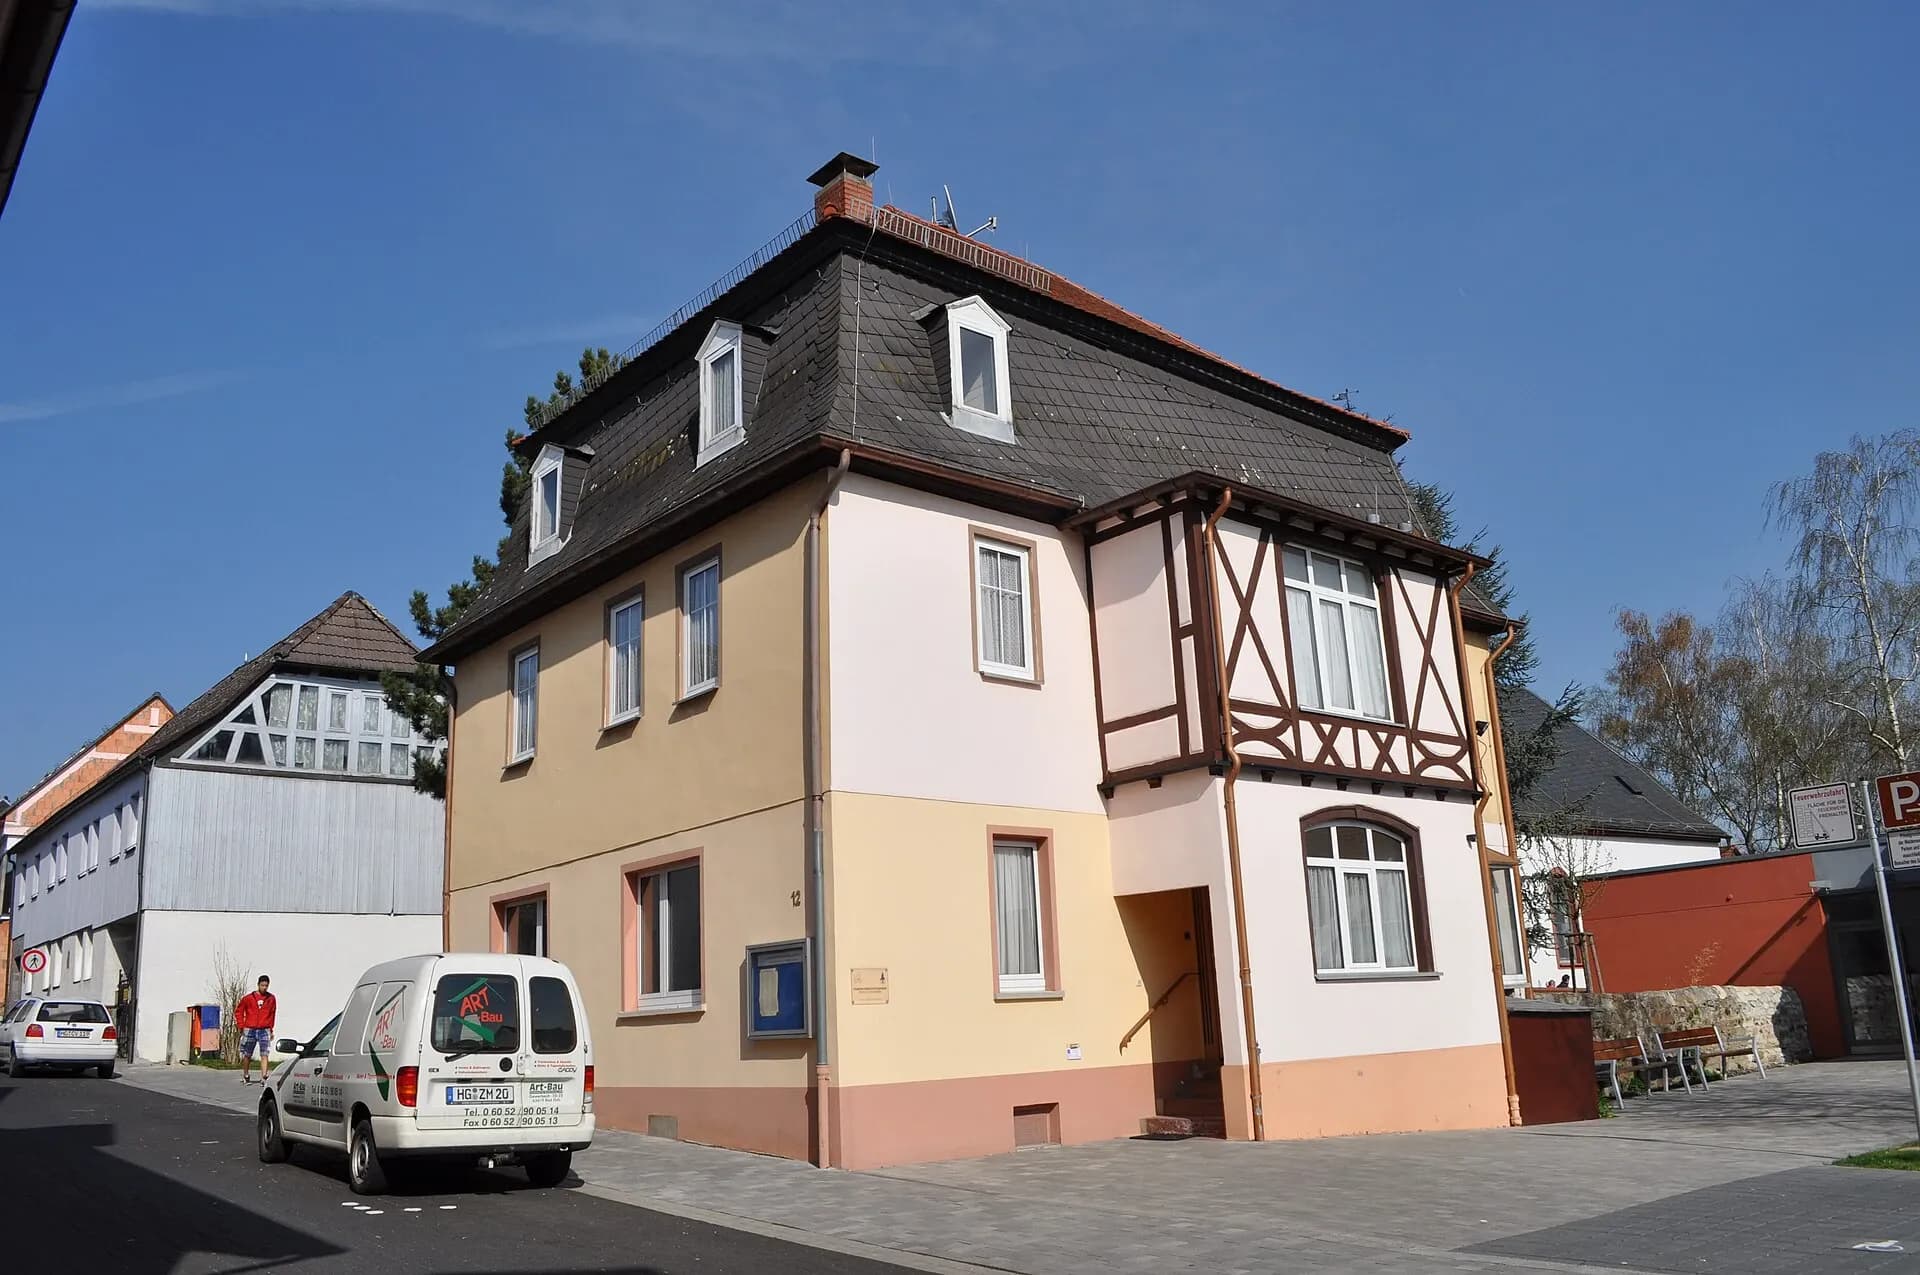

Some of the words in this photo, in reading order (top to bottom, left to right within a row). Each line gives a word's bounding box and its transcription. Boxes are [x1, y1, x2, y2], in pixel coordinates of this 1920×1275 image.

[1794, 788, 1845, 801] Feuerwehrzufahrt
[1889, 780, 1919, 820] P
[791, 890, 801, 907] 12
[460, 986, 489, 1017] ART
[373, 999, 400, 1041] ART
[457, 1089, 472, 1099] HG
[479, 1089, 494, 1099] ZM
[495, 1088, 509, 1099] 20
[529, 1083, 564, 1091] Art-Bau
[464, 1108, 480, 1117] Tel.
[483, 1108, 489, 1116] 0
[491, 1108, 502, 1116] 60
[504, 1108, 516, 1116] 52
[523, 1107, 533, 1116] 90
[536, 1107, 547, 1115] 05
[549, 1107, 559, 1115] 14
[503, 1118, 515, 1126] 52
[521, 1118, 532, 1126] 90
[535, 1117, 546, 1126] 05
[548, 1117, 558, 1125] 13
